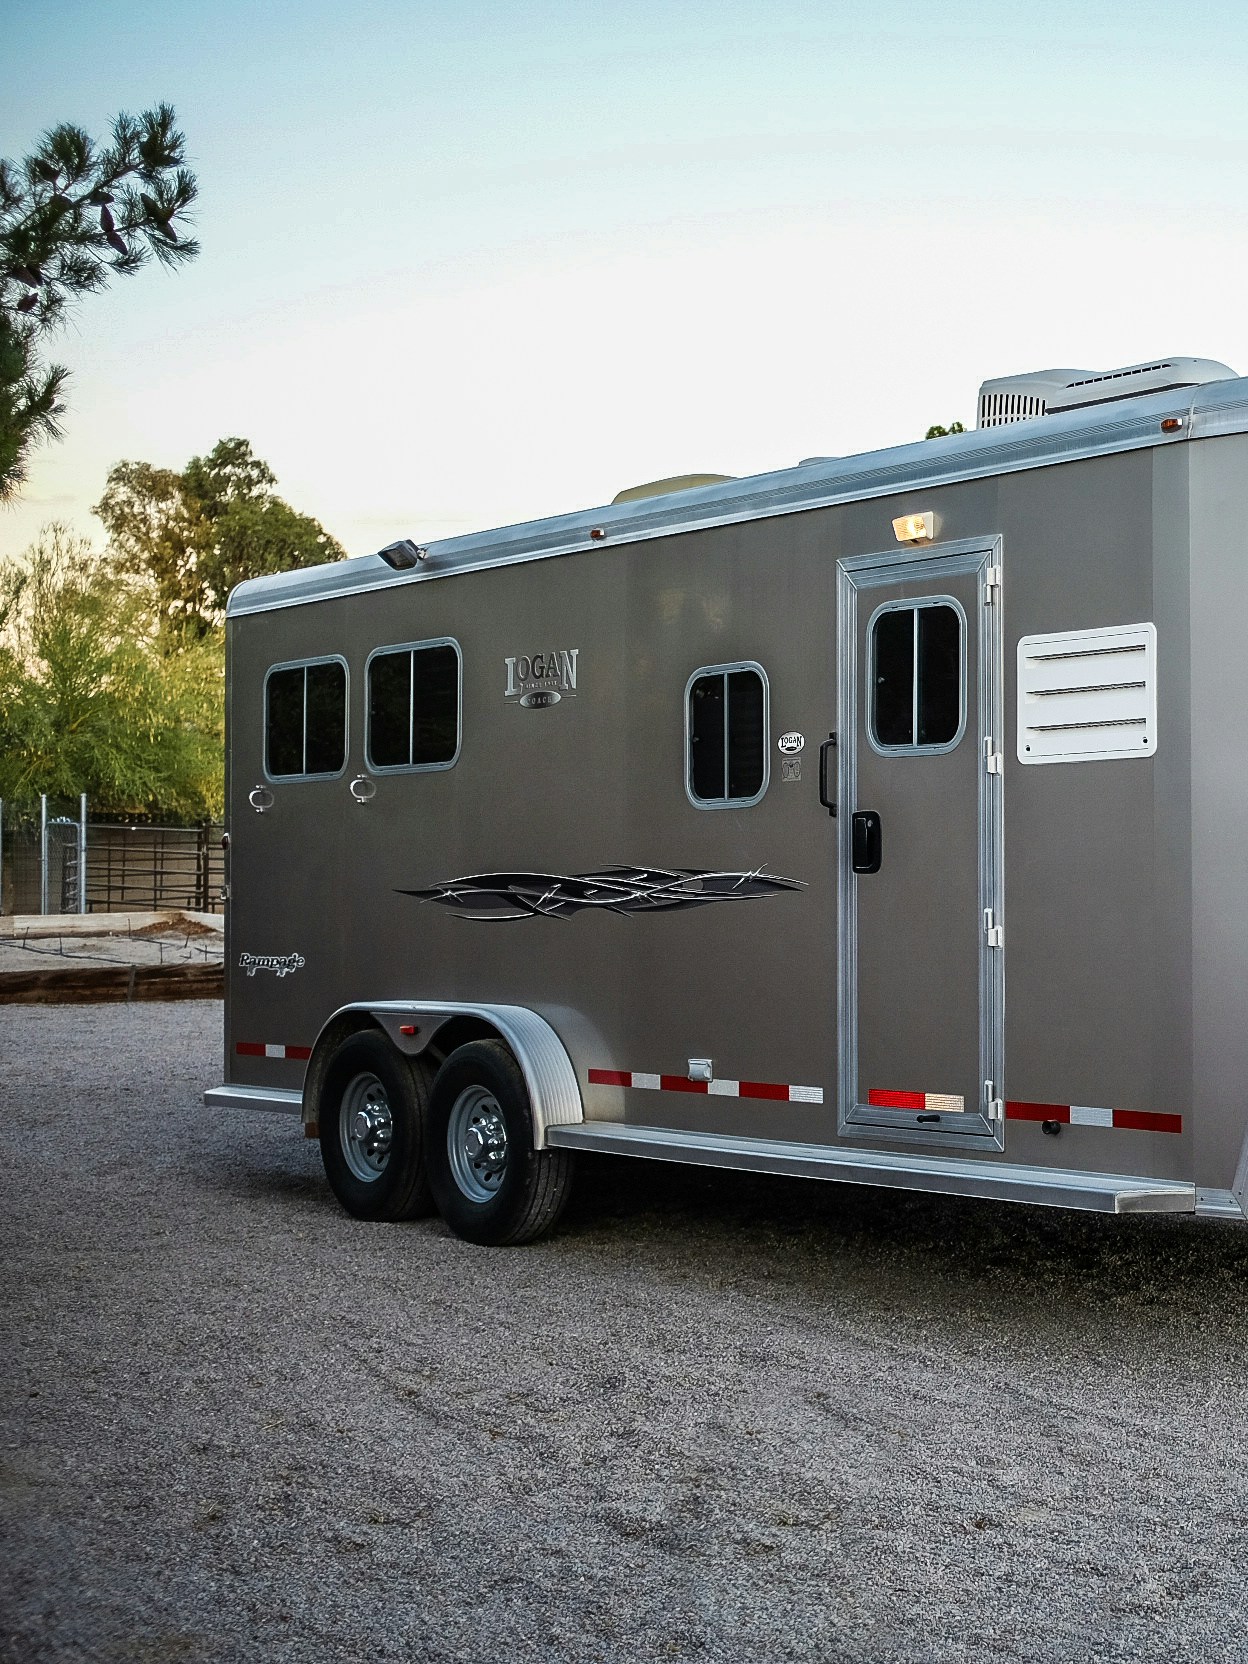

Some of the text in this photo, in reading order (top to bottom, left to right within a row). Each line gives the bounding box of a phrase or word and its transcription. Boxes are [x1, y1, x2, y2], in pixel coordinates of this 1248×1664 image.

[504, 648, 579, 697] LOGAN
[780, 736, 802, 748] LOGAN
[239, 953, 305, 973] Rampage
